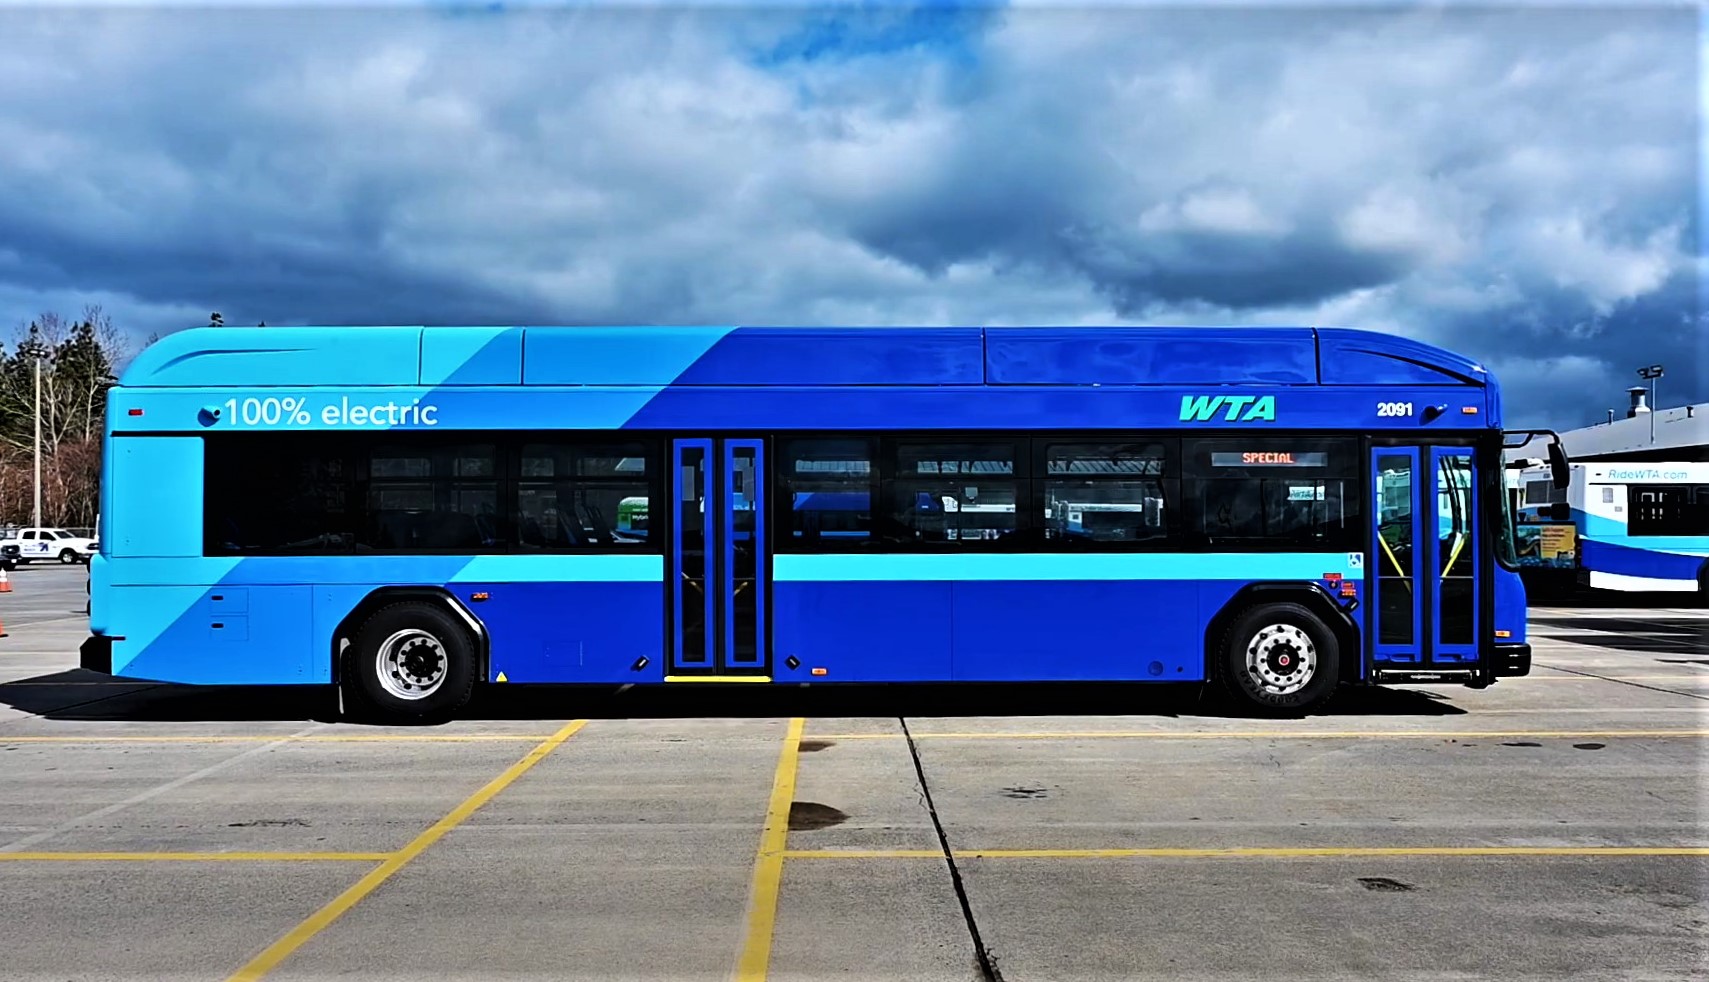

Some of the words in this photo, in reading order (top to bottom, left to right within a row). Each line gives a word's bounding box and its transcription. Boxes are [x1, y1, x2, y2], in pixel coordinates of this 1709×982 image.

[225, 396, 311, 425] 100%
[321, 395, 438, 425] electric
[1179, 395, 1276, 421] WTA
[1376, 402, 1413, 417] 2091
[1242, 452, 1294, 464] SPECIAL
[1608, 469, 1688, 480] RideWTA.com
